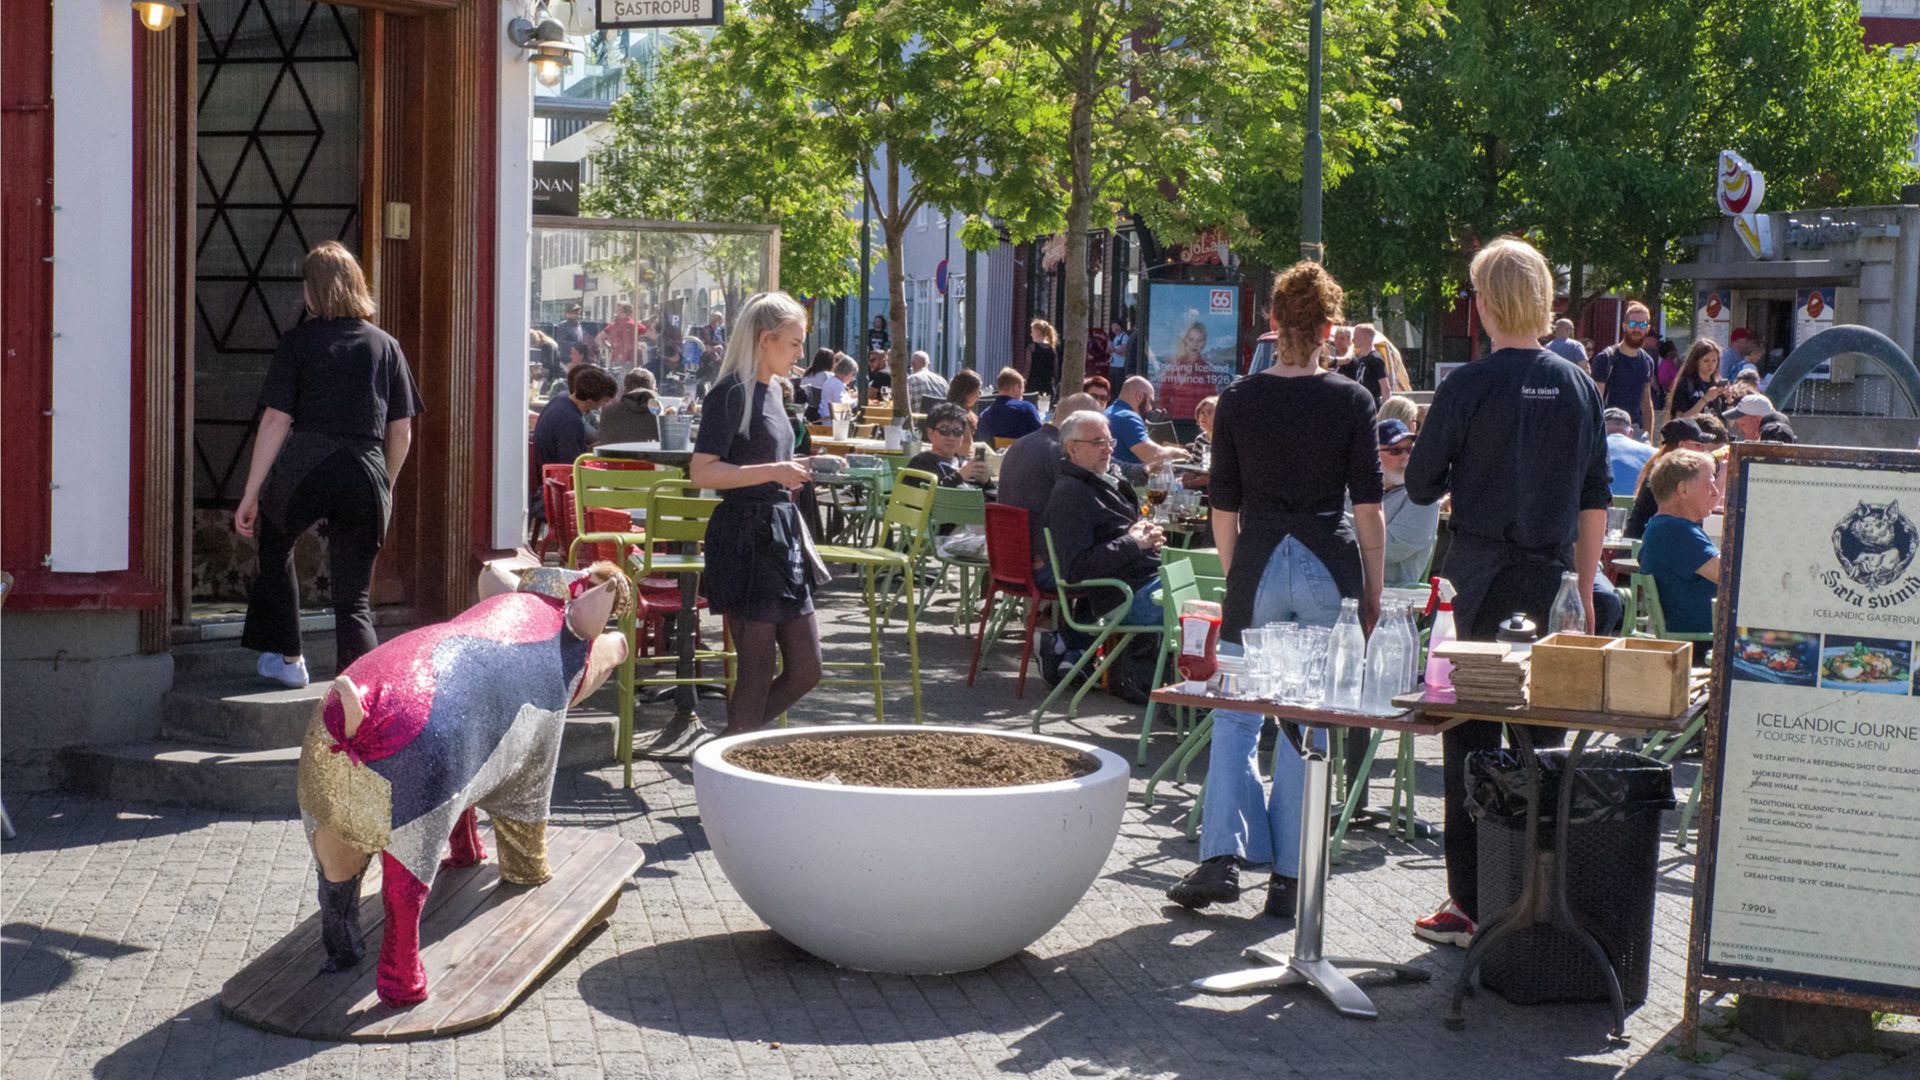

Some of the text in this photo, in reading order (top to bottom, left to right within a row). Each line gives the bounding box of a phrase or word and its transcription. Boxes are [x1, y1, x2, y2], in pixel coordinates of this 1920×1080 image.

[615, 0, 700, 16] GASTROPUB
[1212, 292, 1230, 307] 66
[1195, 363, 1229, 373] Iceland
[1180, 374, 1204, 384] since
[1207, 375, 1230, 385] 1926
[1813, 609, 1865, 620] ICELANDIC
[1756, 713, 1920, 741] ICELANDIC JOURNE
[1755, 730, 1890, 751] 7 COURSE TASTING MENU
[1765, 754, 1786, 762] START
[1787, 756, 1806, 764] WITH
[1813, 759, 1855, 769] REFRESHING
[1752, 770, 1781, 778] SMOKED
[1782, 773, 1807, 781] PUFFIN
[1750, 798, 1796, 809] TRADITIONAL
[1797, 803, 1835, 813] ICELANDIC
[1748, 817, 1771, 825] HORSE
[1745, 853, 1782, 863] ICELANDIC
[1783, 857, 1802, 865] LAMB
[1803, 859, 1823, 867] RUMP
[1743, 871, 1767, 880] CREAM
[1769, 874, 1795, 883] CHEESE
[1721, 951, 1736, 959] Open
